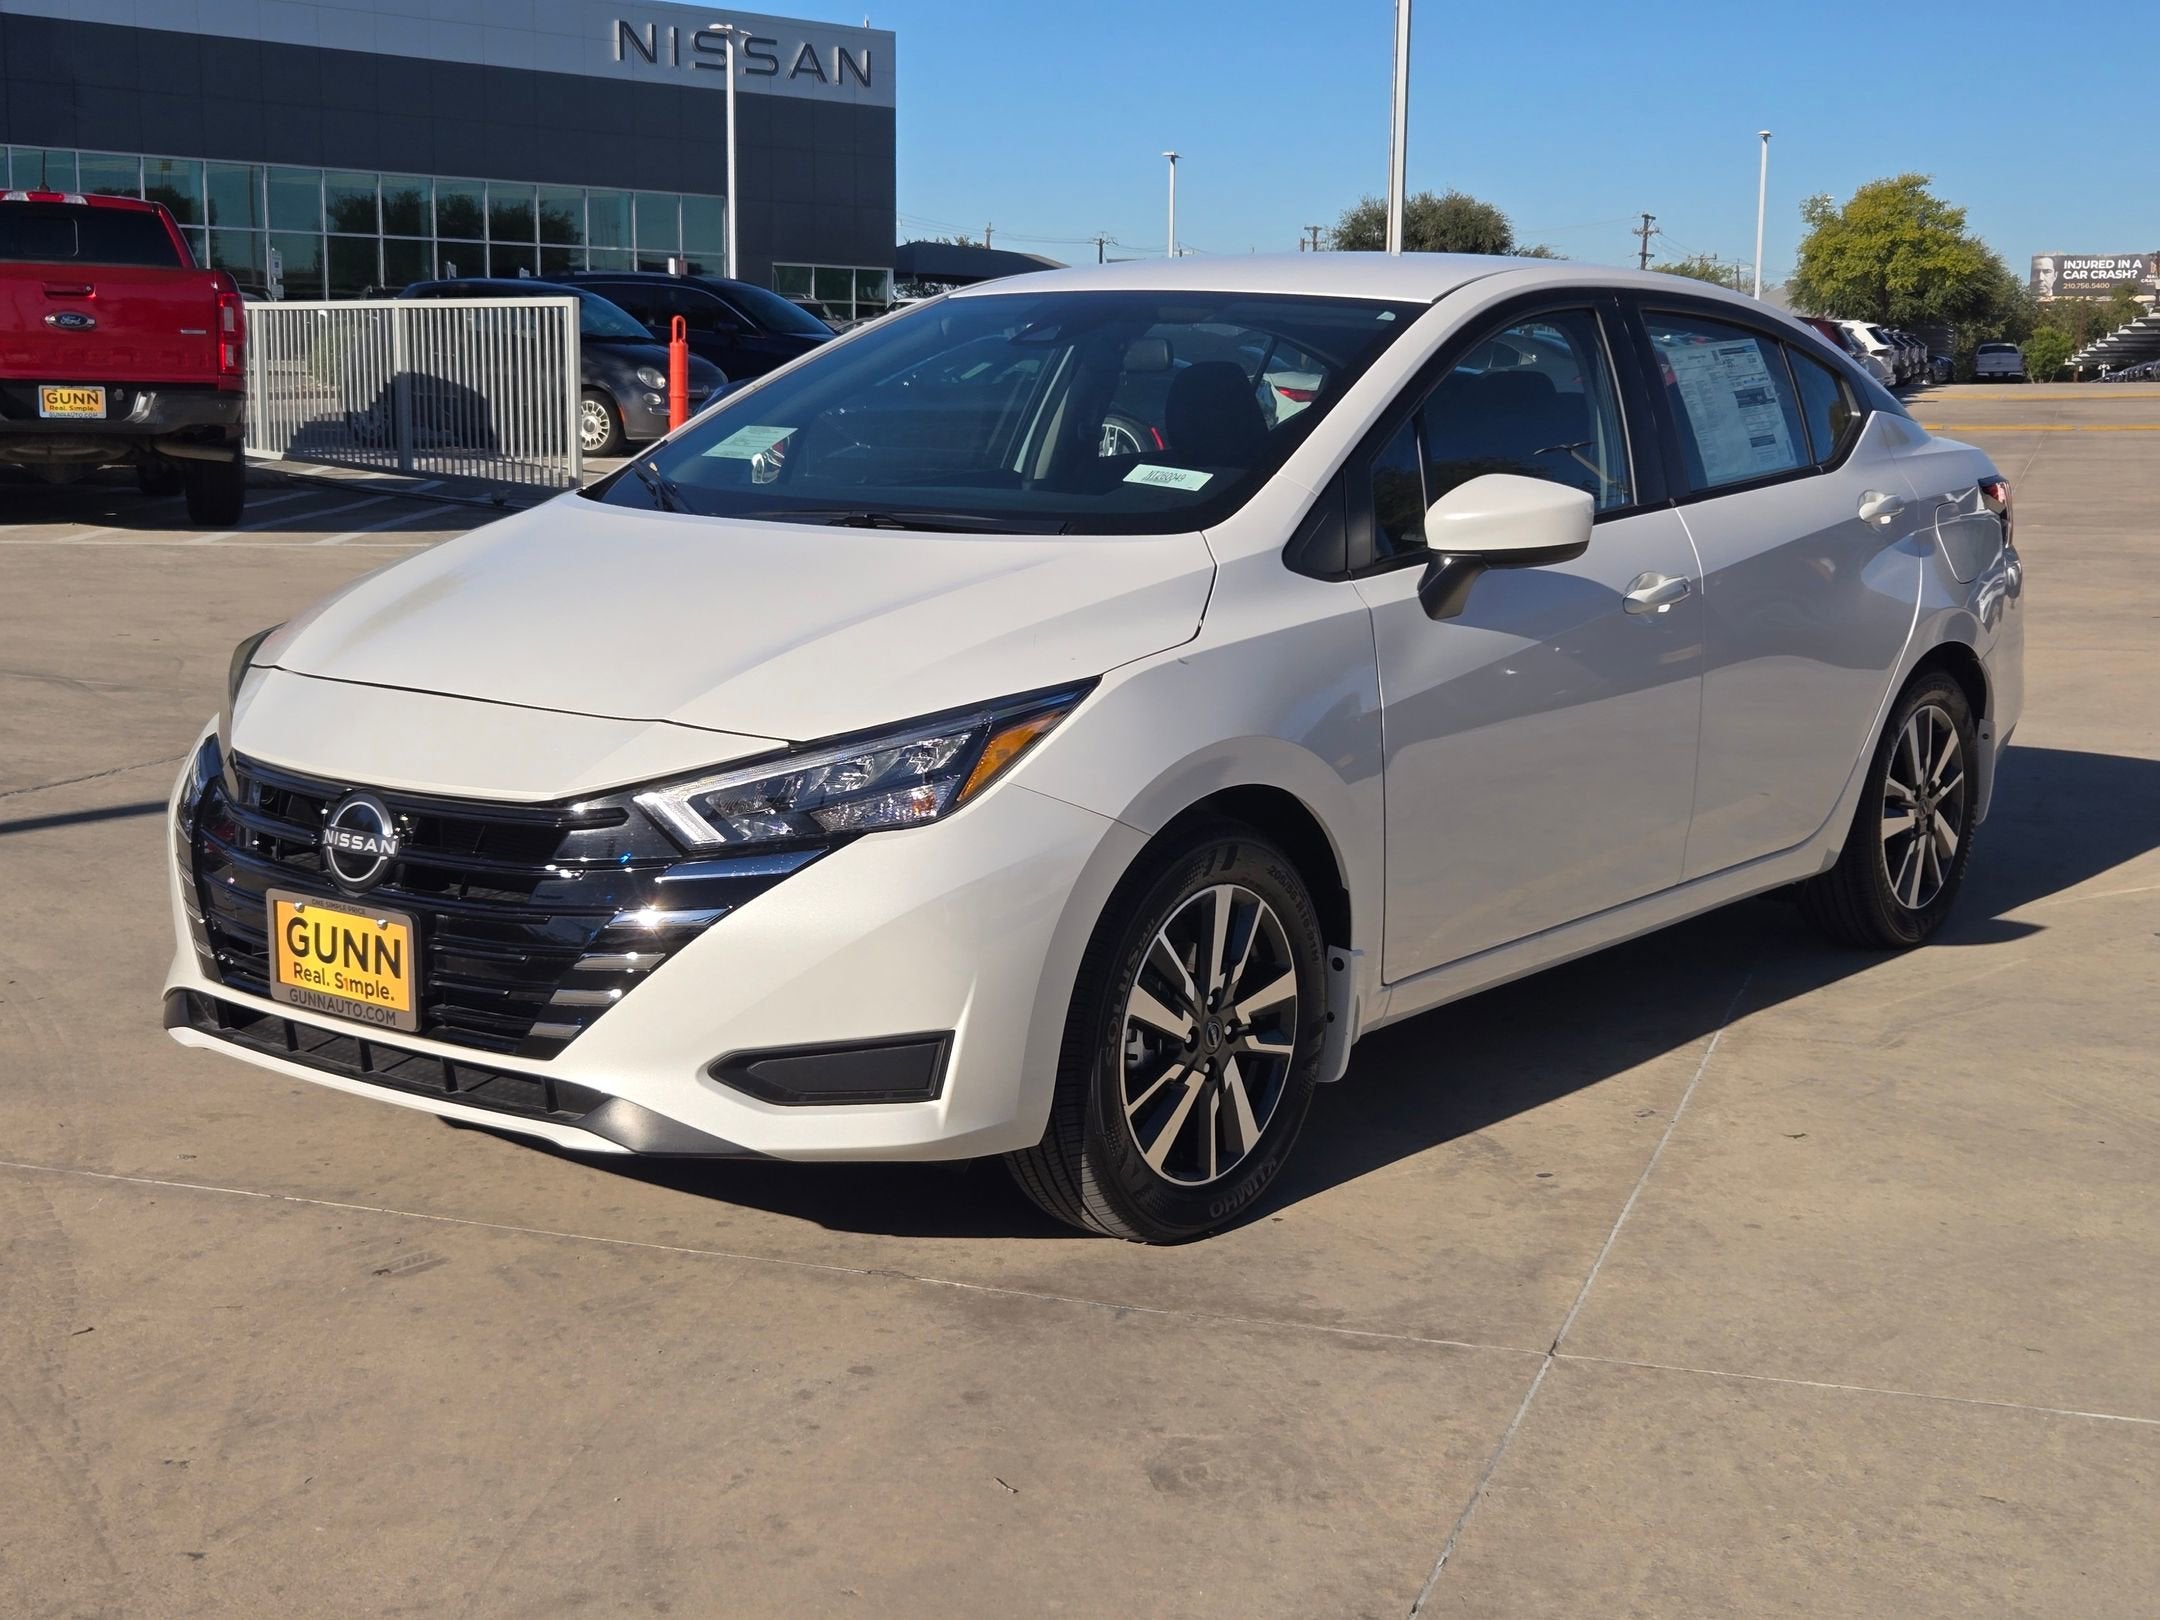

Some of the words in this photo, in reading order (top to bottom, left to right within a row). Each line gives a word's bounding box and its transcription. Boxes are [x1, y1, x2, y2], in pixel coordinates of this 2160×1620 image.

[614, 19, 872, 88] NISSAN
[2063, 259, 2115, 269] INJURED
[2117, 259, 2130, 269] IN
[2132, 259, 2143, 269] A
[2063, 270, 2088, 279] CAR
[2090, 269, 2138, 279] CRASH?
[60, 314, 82, 325] Ford
[46, 392, 99, 405] GUNN
[324, 828, 397, 855] NISSAN
[286, 916, 401, 980] GUNN
[293, 962, 330, 987] Real.
[289, 988, 397, 1026] GUNNAUTO.COM
[1209, 1157, 1277, 1218] KUMHO
